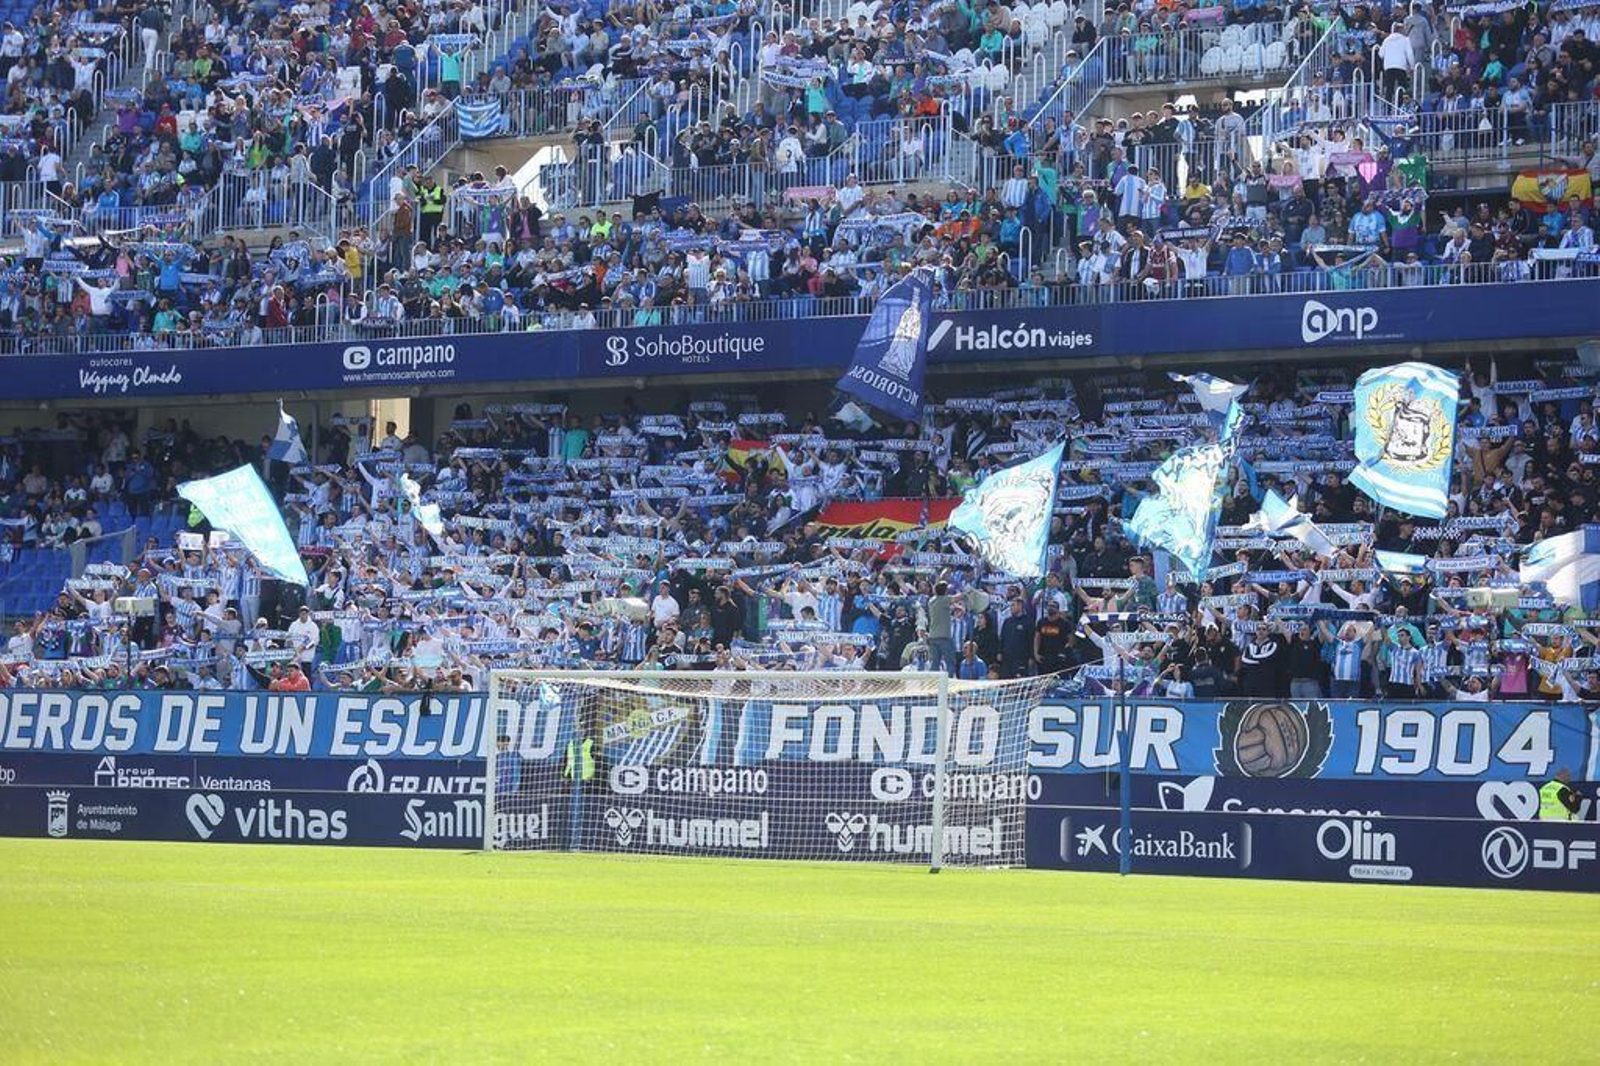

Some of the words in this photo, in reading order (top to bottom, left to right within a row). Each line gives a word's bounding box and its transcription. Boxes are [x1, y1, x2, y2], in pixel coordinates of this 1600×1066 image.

[634, 333, 766, 359] SohoBoutique
[955, 322, 1047, 351] Halcón
[1049, 331, 1093, 349] viajes
[89, 359, 133, 367] autocares
[376, 343, 455, 369] campano
[343, 369, 455, 382] www.hermanoscampano.com
[153, 694, 227, 753] DE
[240, 696, 319, 755] UN
[330, 697, 561, 760] ESCUDO
[765, 704, 1000, 764] FONDO
[1027, 705, 1185, 771] SUR
[1355, 709, 1555, 777] 1904
[200, 775, 272, 791] Ventanas
[657, 767, 768, 797] campano
[922, 772, 1043, 804] cmpano
[235, 799, 348, 841] vithas
[648, 810, 768, 849] hummel
[1112, 822, 1236, 860] CaixaBank
[1316, 819, 1396, 861] Olin
